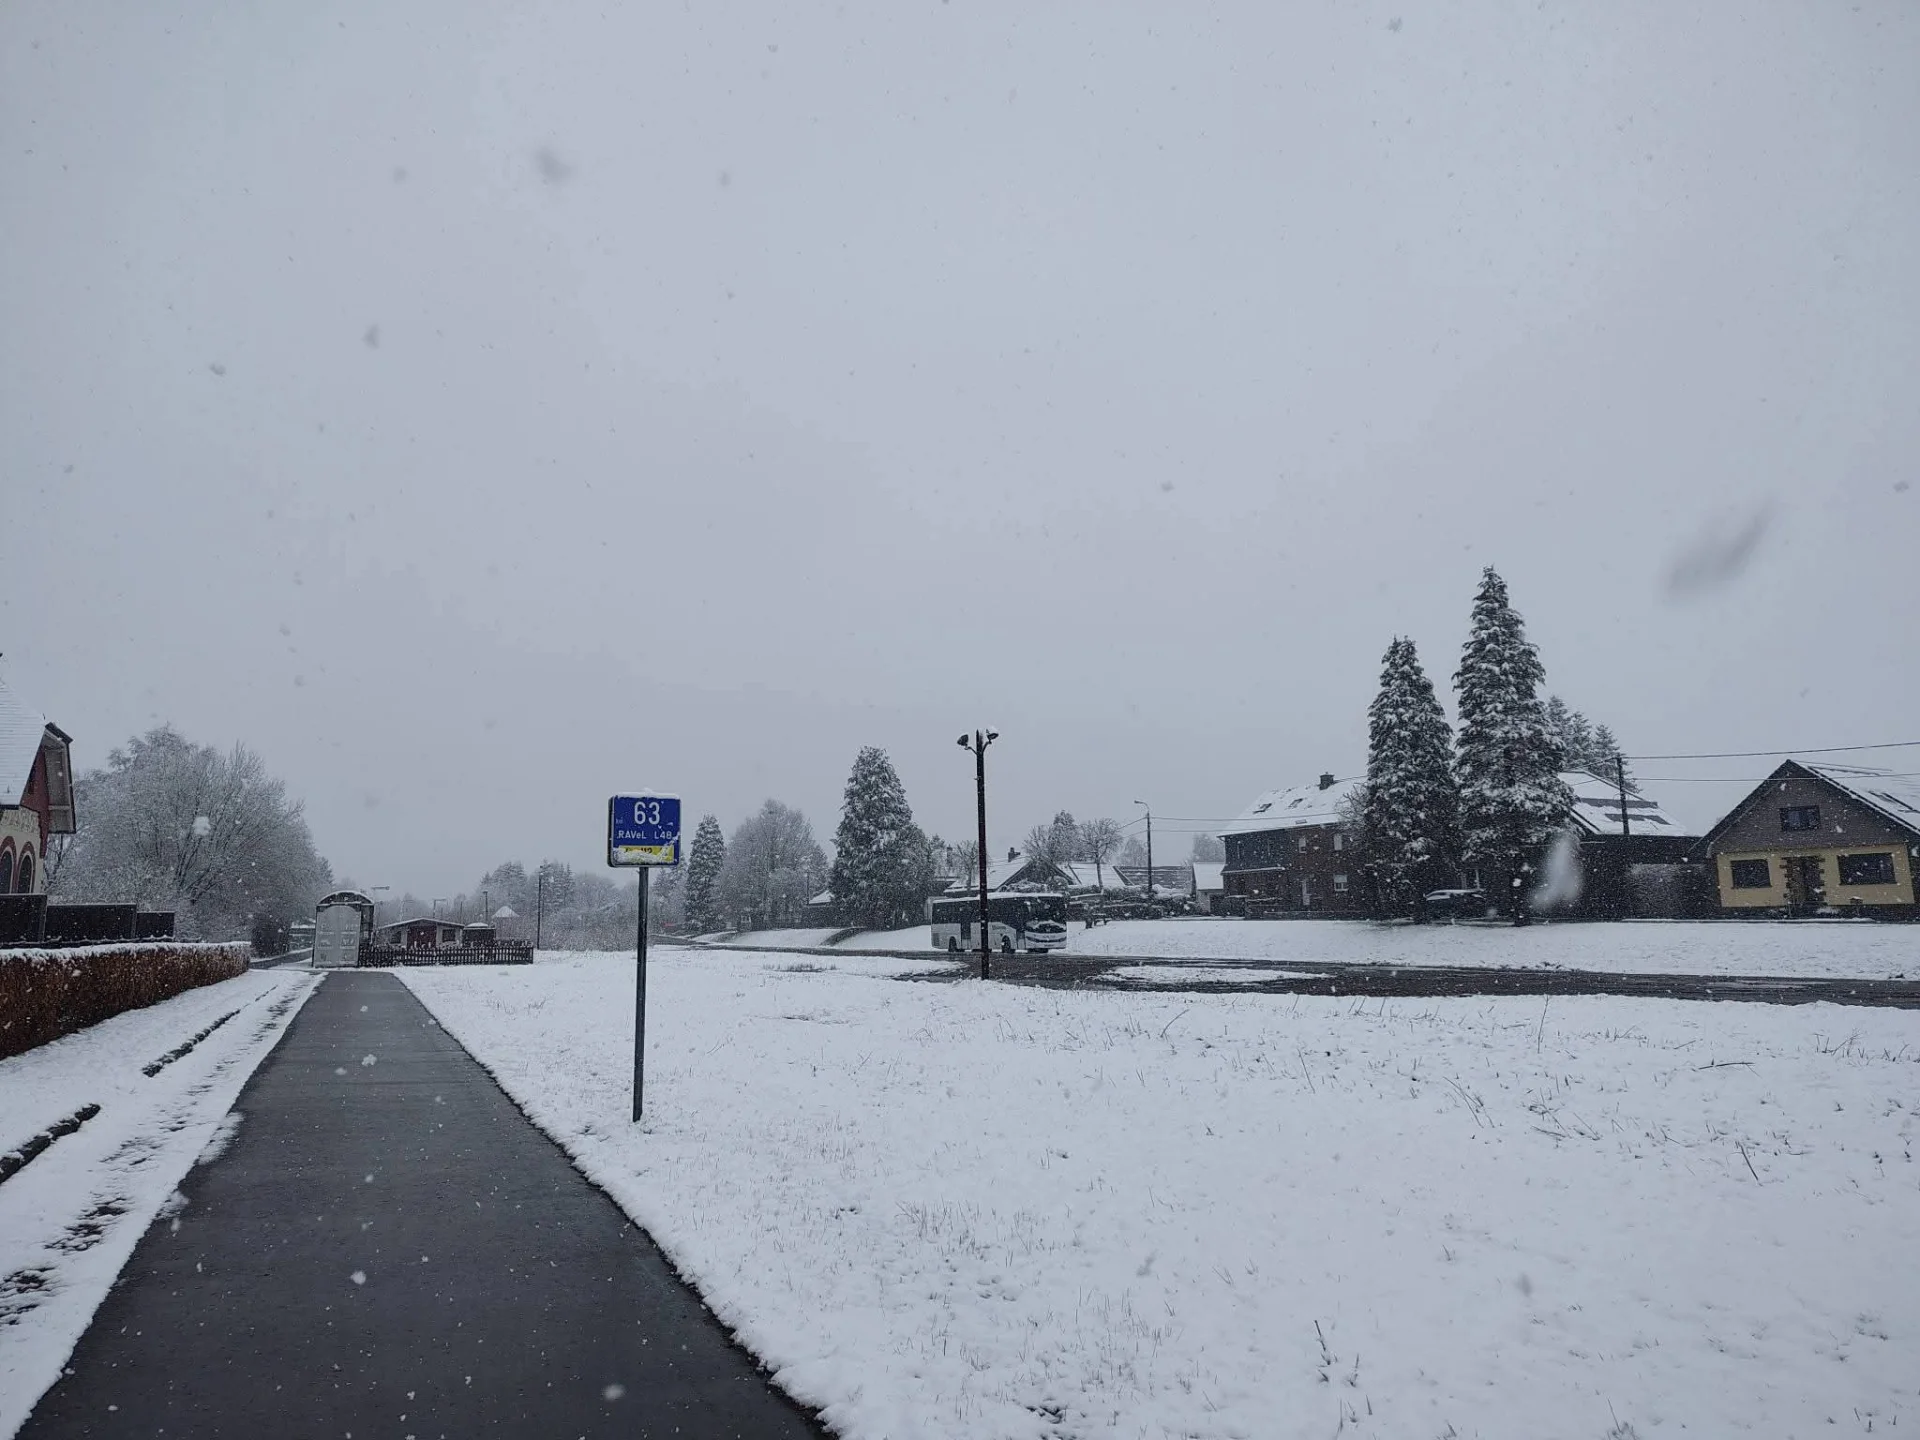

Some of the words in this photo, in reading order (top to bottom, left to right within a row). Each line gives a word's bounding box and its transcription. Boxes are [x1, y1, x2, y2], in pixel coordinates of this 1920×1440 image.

[634, 801, 660, 825] 63
[618, 830, 647, 840] RAVeL
[654, 830, 673, 840] L48
